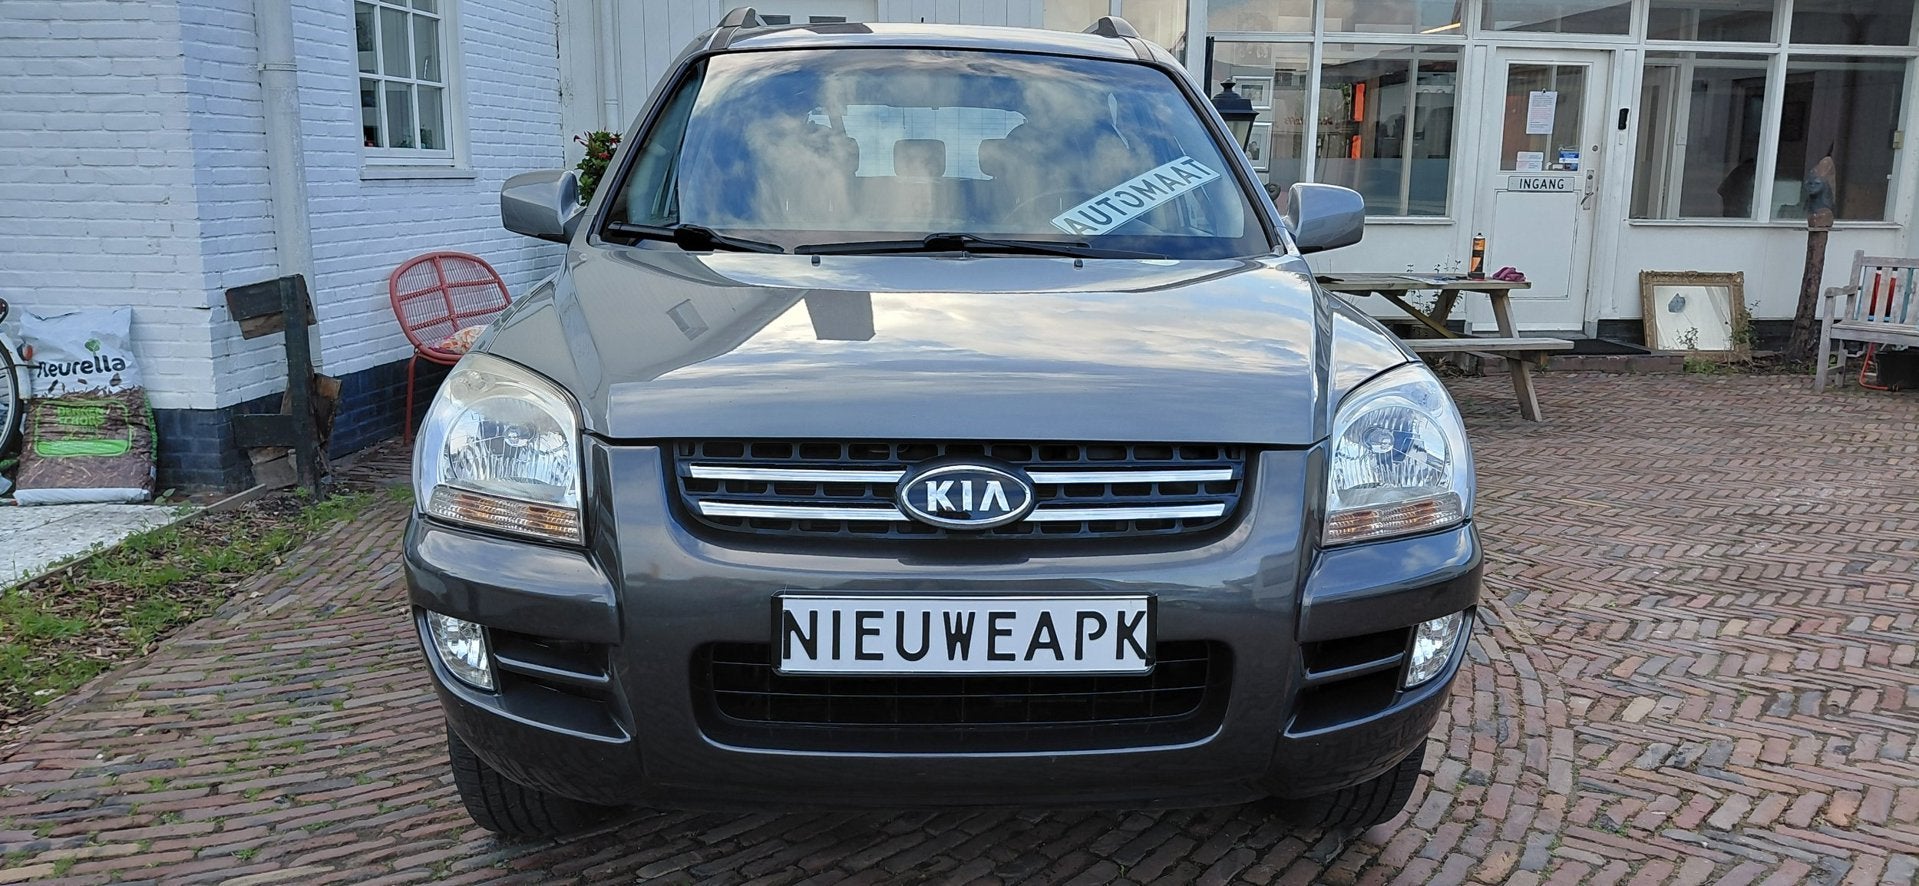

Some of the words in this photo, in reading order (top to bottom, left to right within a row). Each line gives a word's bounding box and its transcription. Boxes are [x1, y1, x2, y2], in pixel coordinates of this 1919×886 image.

[1063, 158, 1211, 235] AUTOMAAT
[1519, 178, 1565, 190] INGANG
[925, 480, 1011, 512] KIA
[782, 609, 1147, 662] NIEUWEAPK
